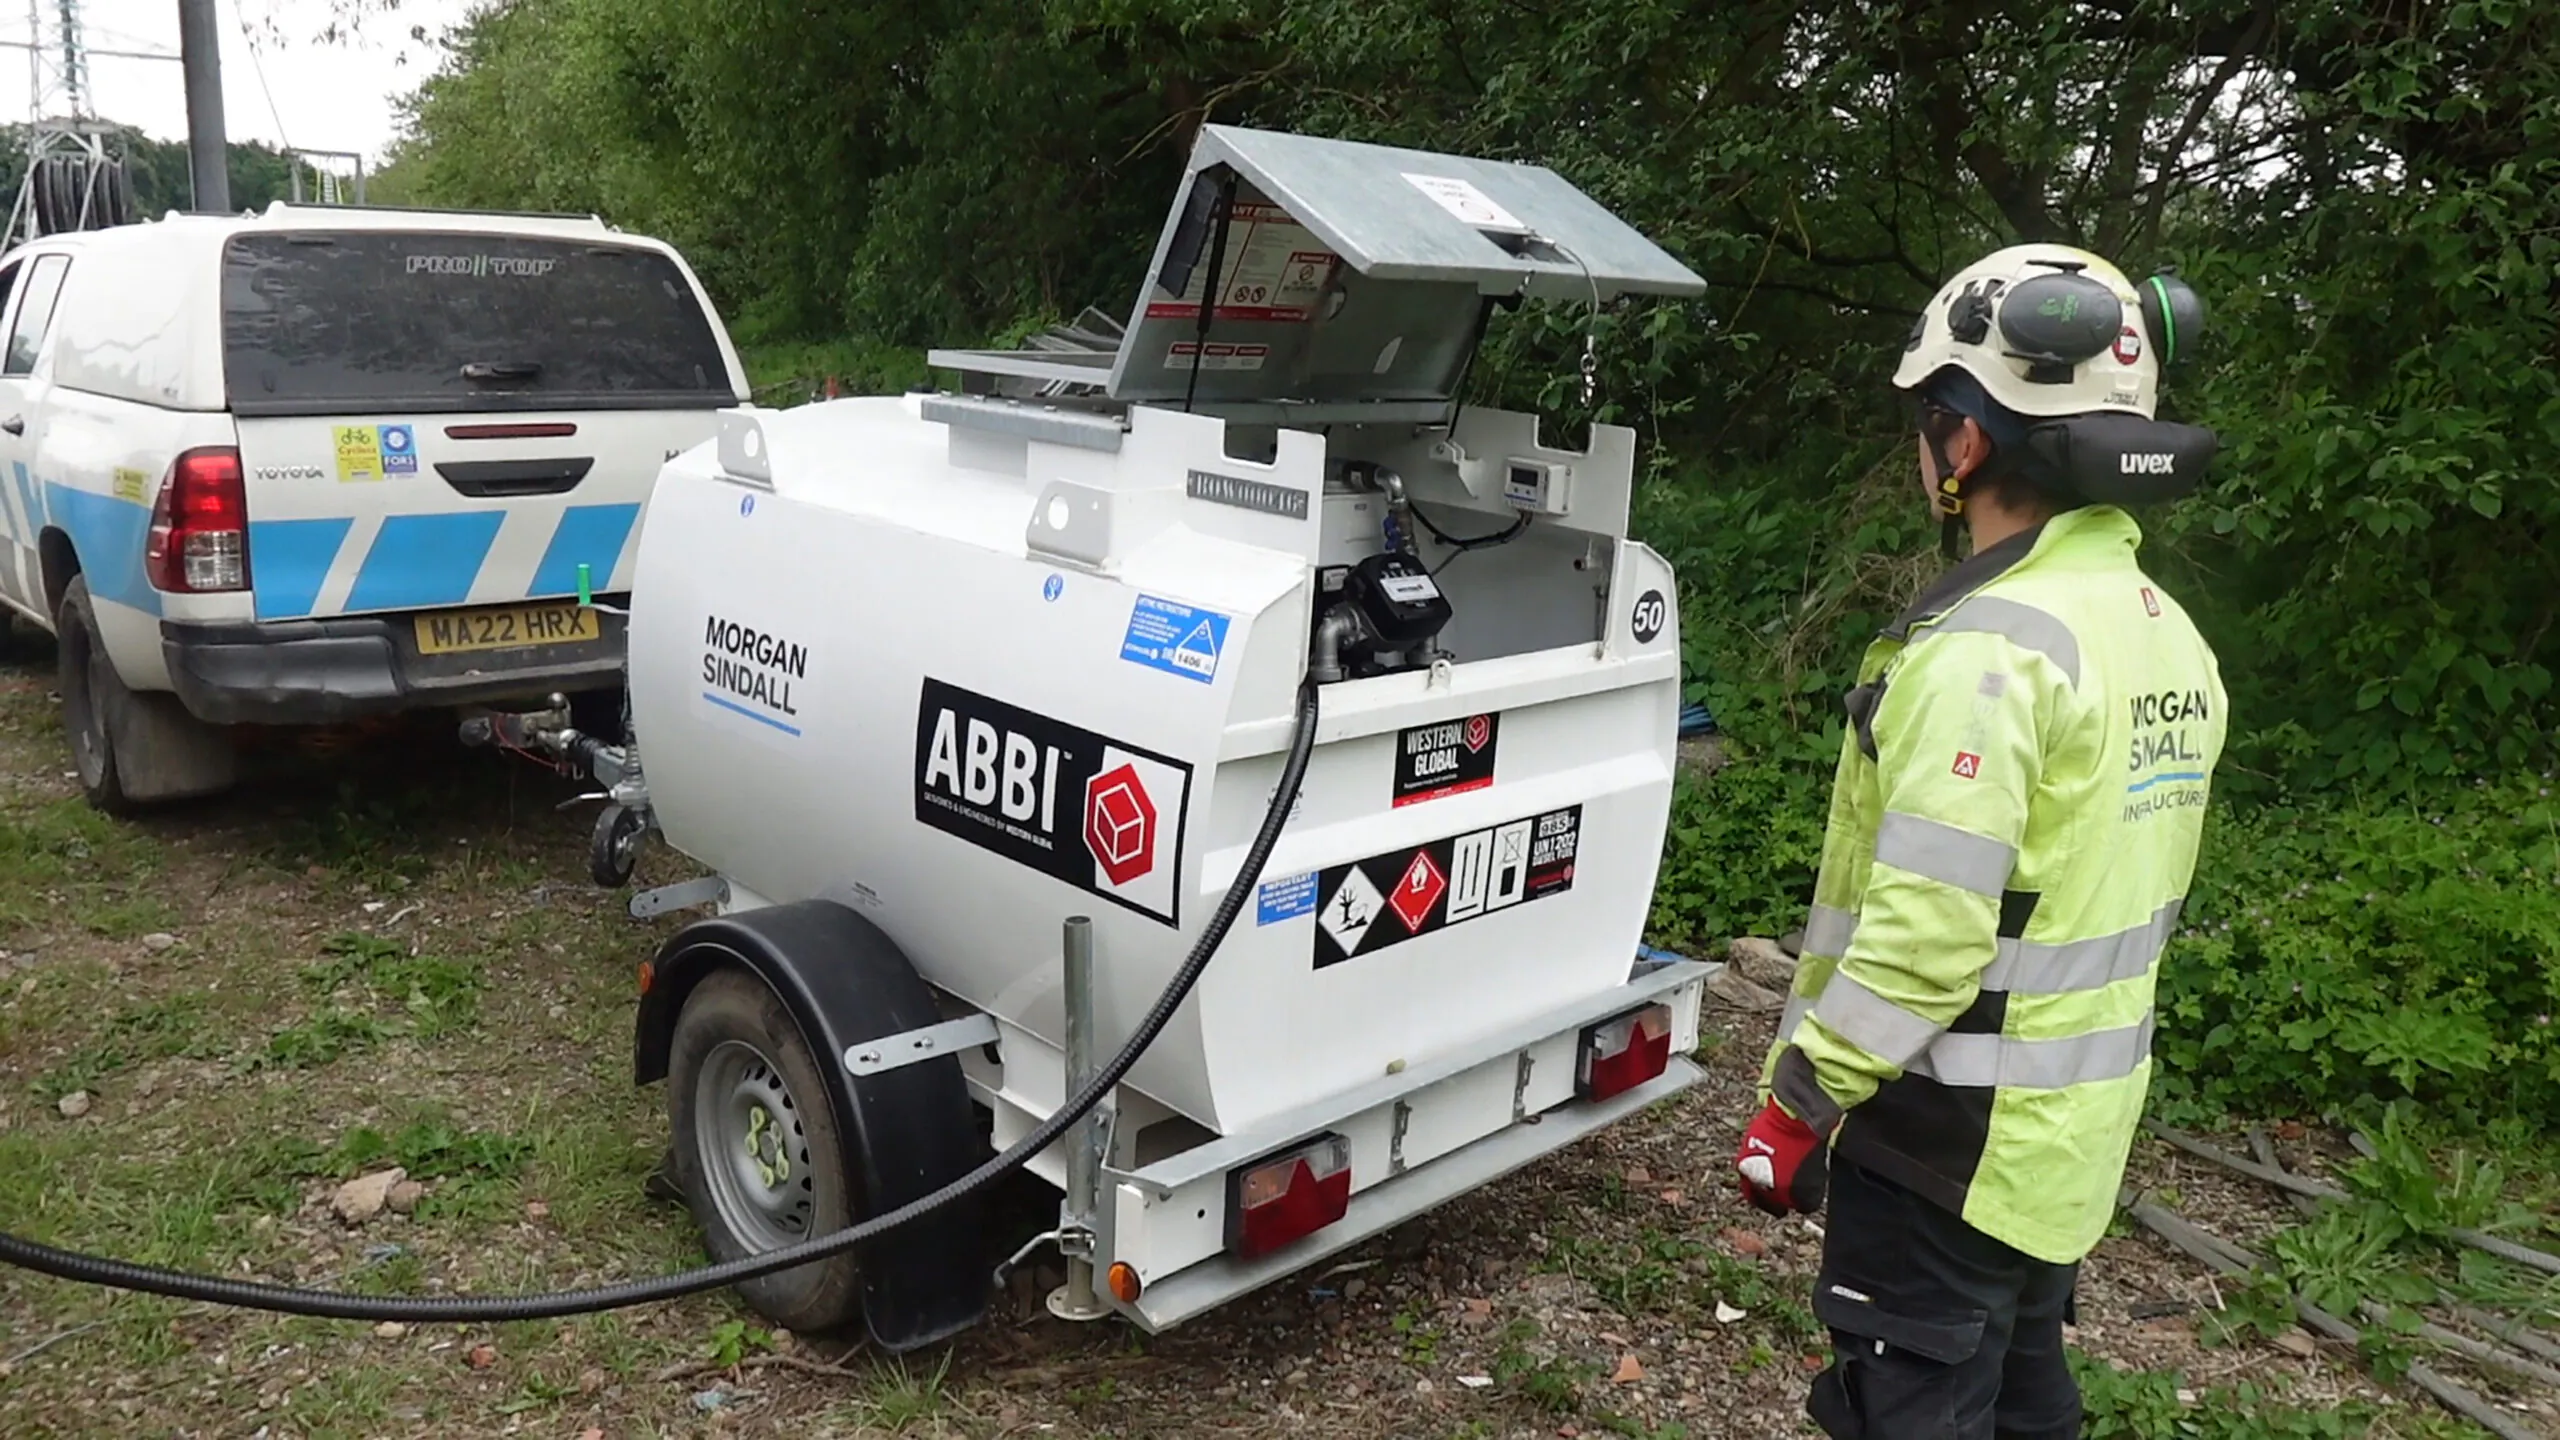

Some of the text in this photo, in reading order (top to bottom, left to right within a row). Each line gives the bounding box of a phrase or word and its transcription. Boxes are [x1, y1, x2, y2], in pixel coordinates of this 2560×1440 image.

[255, 465, 324, 480] TOYOTA
[384, 456, 414, 466] FORS
[2120, 452, 2175, 474] uvex
[430, 606, 586, 648] MA22 HRX
[1633, 600, 1663, 633] 50
[705, 614, 808, 680] MORGAN
[702, 652, 798, 716] SINDALL
[1407, 721, 1463, 755] WESTERN
[1415, 747, 1459, 777] GLOBAL
[1533, 831, 1576, 856] UN1202
